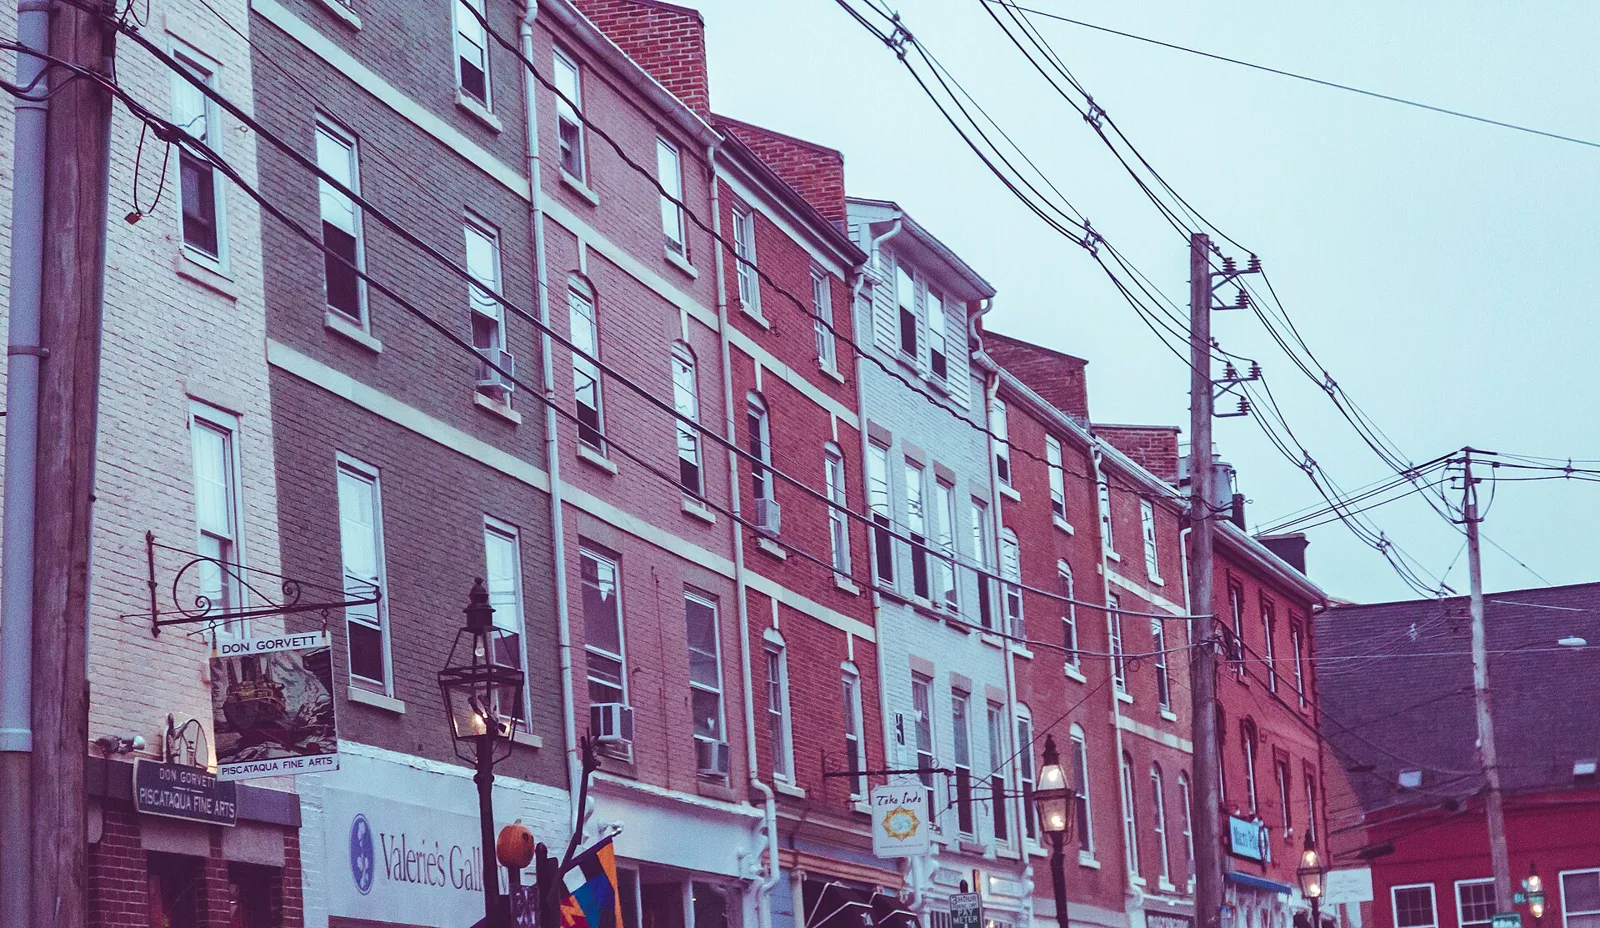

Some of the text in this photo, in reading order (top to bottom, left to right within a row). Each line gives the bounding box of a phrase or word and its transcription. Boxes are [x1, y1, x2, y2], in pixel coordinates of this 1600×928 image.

[222, 635, 317, 654] DON GORVETT
[221, 756, 333, 776] PISCATAQUA FINE ARTS
[159, 768, 216, 789] DON GORVETT
[140, 787, 235, 819] PISCATAQUA FINE ARTS
[379, 832, 446, 888] Valerie's
[952, 915, 978, 925] METER
[958, 908, 974, 917] PAY
